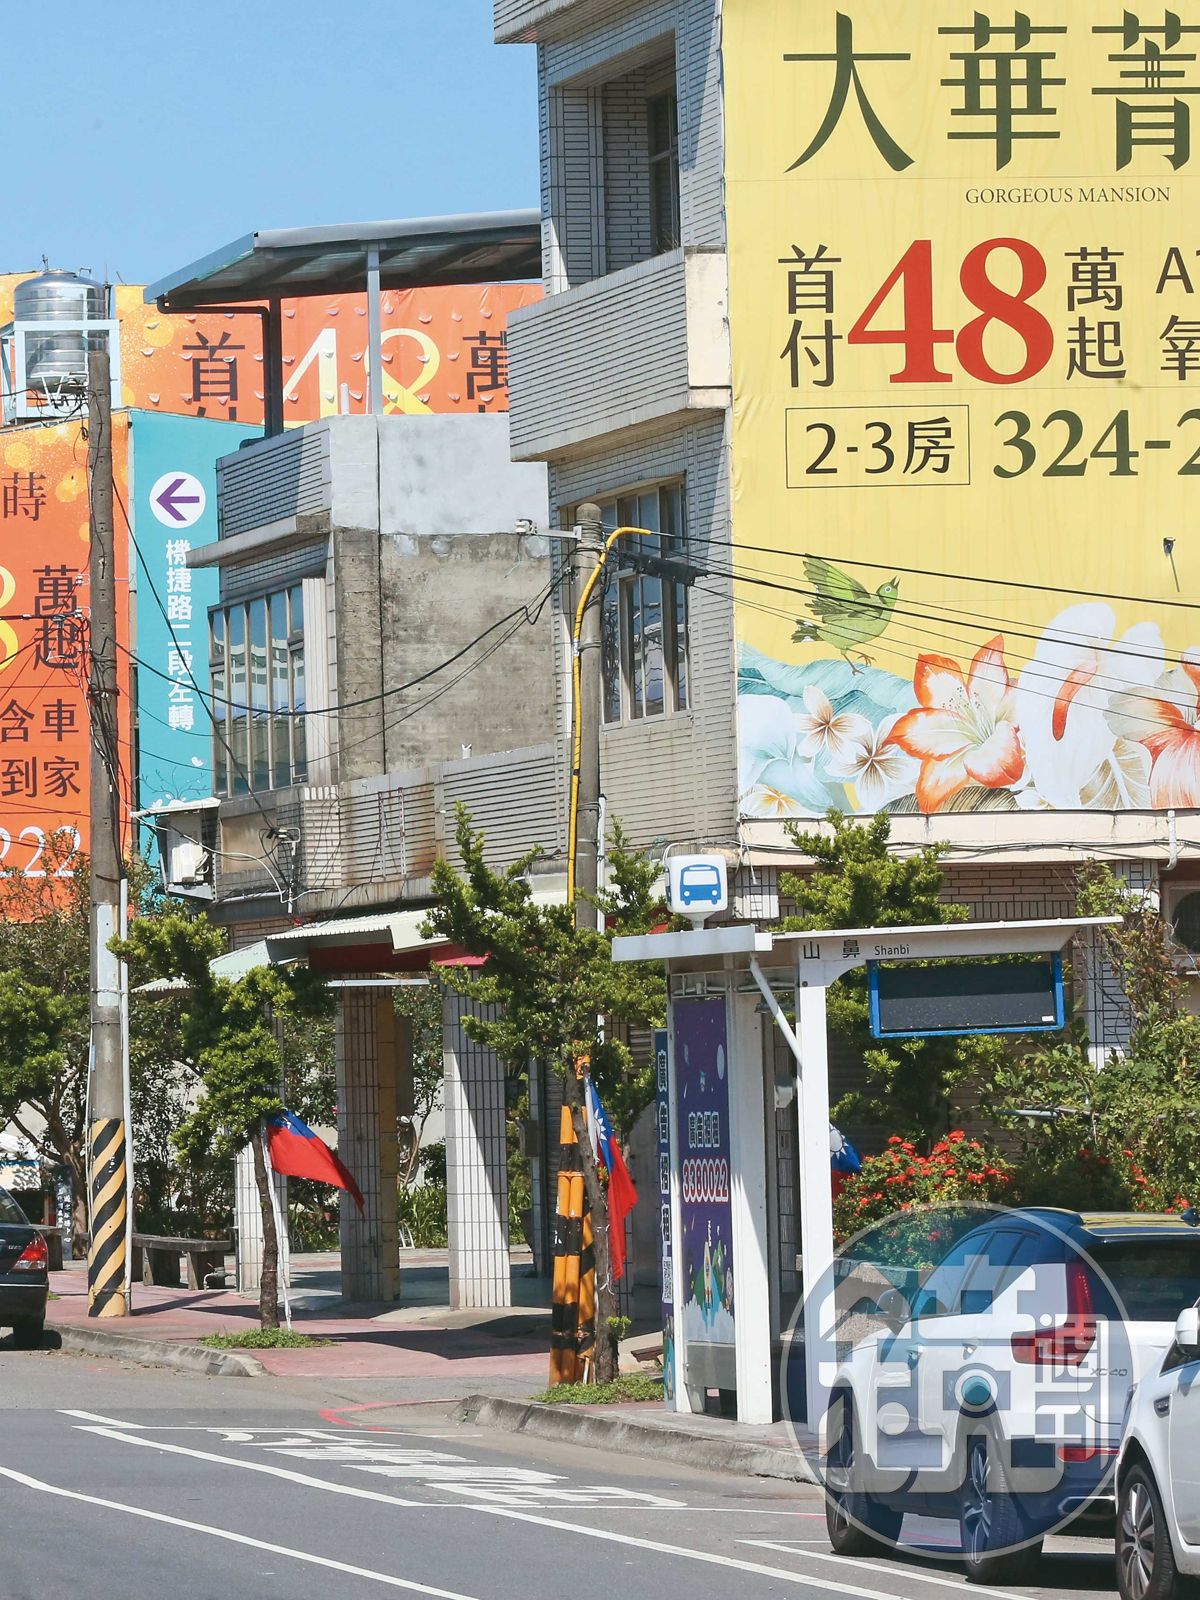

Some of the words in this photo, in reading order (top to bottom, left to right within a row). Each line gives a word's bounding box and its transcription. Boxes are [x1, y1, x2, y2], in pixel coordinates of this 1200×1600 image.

[783, 8, 1200, 174] 大華菁
[965, 187, 1074, 205] GORGEOUS
[1078, 186, 1171, 203] MANSION
[778, 244, 843, 388] 首付
[848, 237, 1054, 385] 48
[1064, 246, 1127, 381] 萬起
[874, 943, 910, 956] Shanbi
